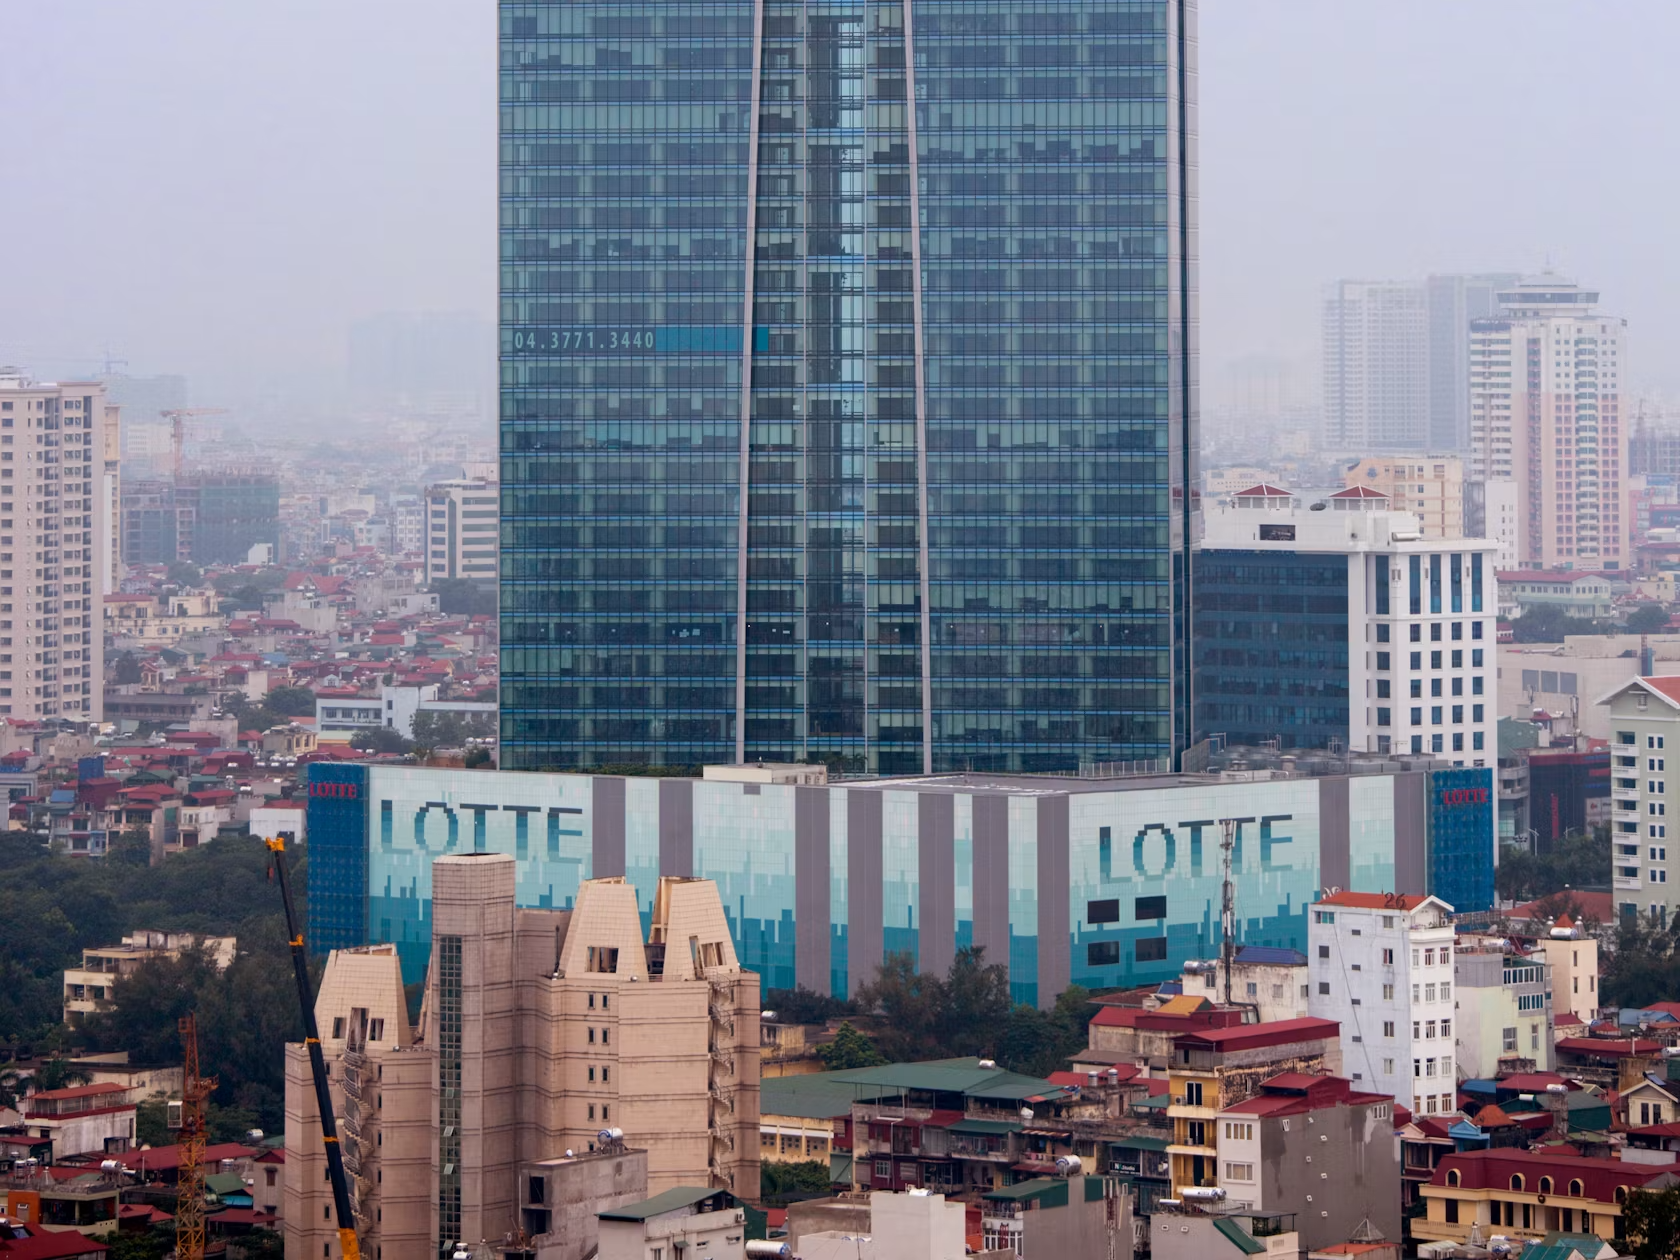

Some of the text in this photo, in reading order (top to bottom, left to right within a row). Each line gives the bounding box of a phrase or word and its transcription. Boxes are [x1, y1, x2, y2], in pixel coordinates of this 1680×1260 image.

[514, 331, 654, 349] 04.3771.3440
[309, 781, 357, 799] LOTTE
[1444, 787, 1489, 805] LOTTE
[381, 799, 583, 864] LOTTE
[1099, 814, 1293, 883] LOTTE
[1384, 891, 1406, 909] 26
